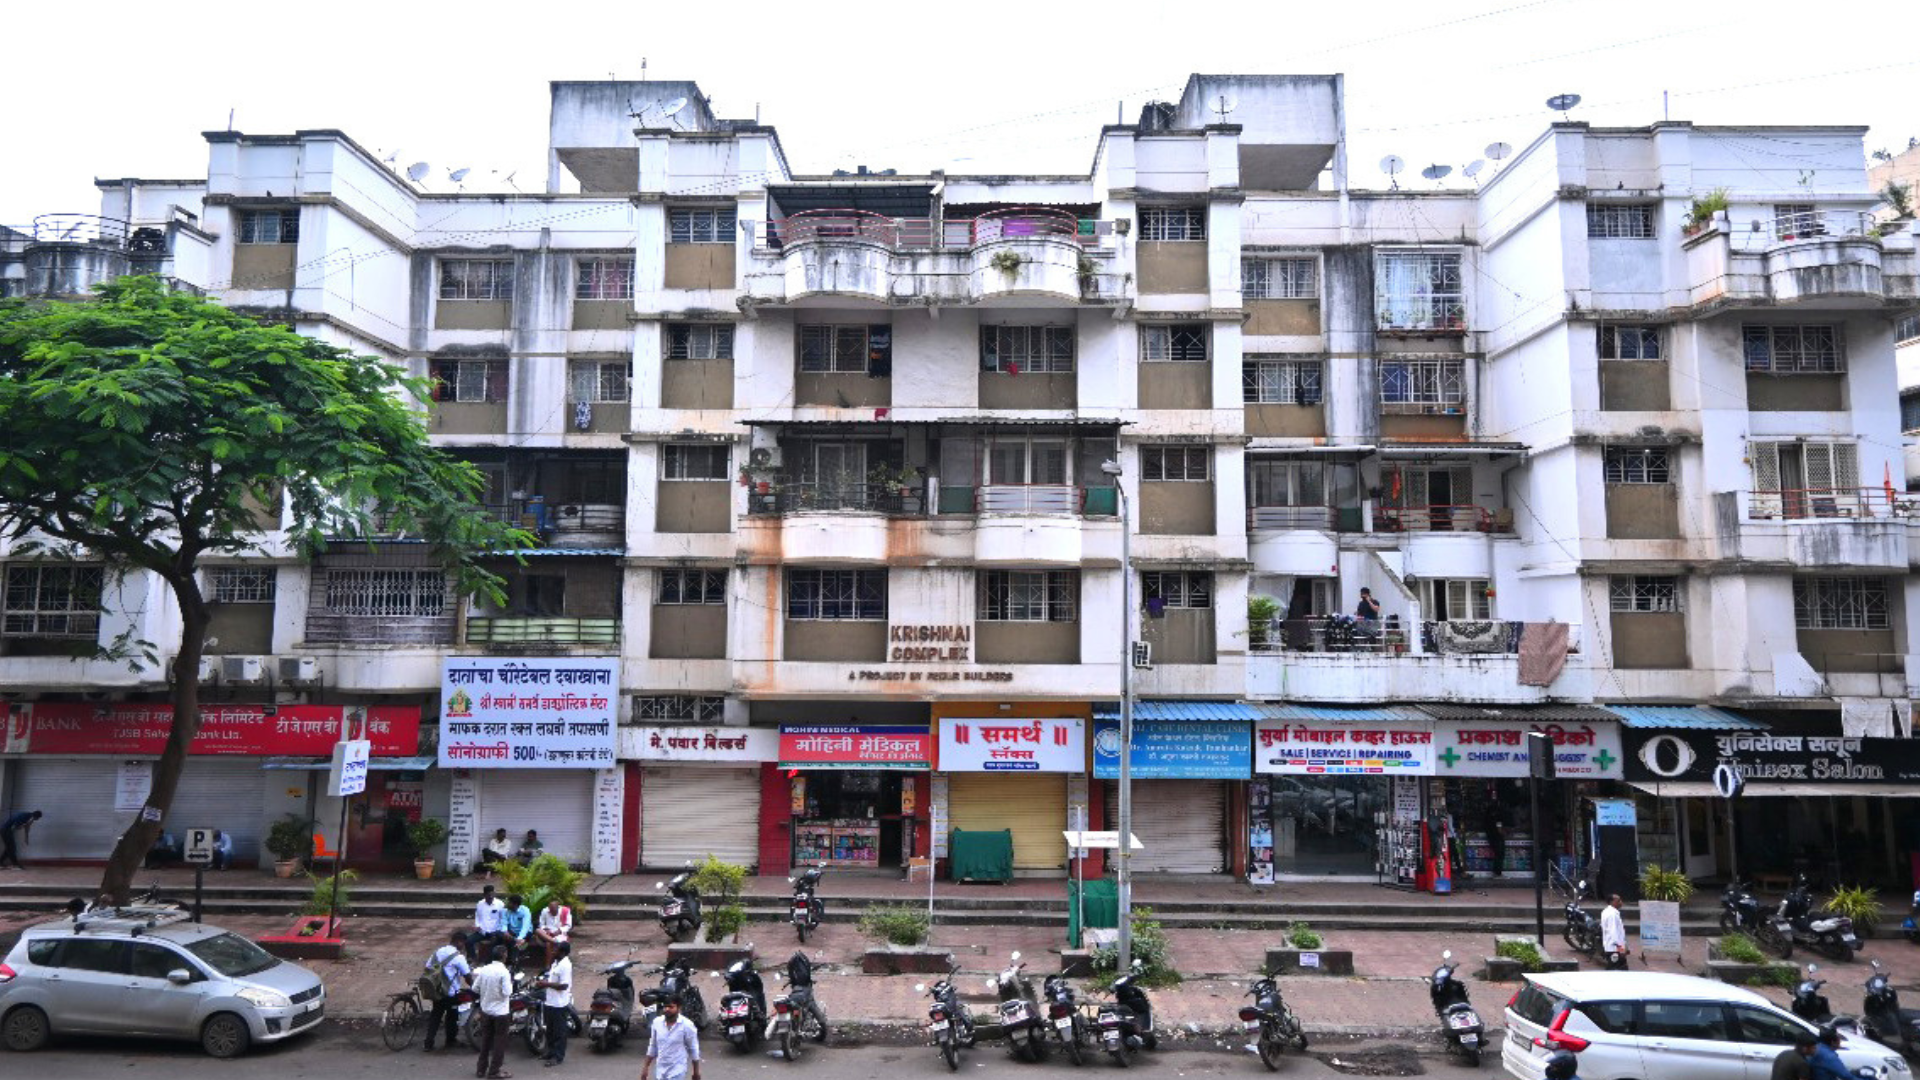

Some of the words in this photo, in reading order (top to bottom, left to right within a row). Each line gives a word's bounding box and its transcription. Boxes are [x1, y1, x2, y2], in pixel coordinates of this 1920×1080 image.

[890, 625, 970, 642] KRISHNAI
[36, 717, 82, 730] BANK
[980, 720, 1044, 744] समर्थ
[668, 736, 699, 750] पवार
[795, 736, 853, 754] मोहिनी
[859, 736, 921, 752] मेडिकल
[1457, 729, 1523, 746] प्रकाश
[1280, 748, 1304, 758] SALE
[1311, 749, 1351, 759] SERVICE
[1358, 749, 1412, 760] REPAIRING
[1467, 752, 1510, 762] CHEMIST
[1512, 753, 1530, 763] AN
[1553, 753, 1588, 763] GGIST
[1812, 756, 1885, 780] Salon
[194, 831, 205, 848] P
